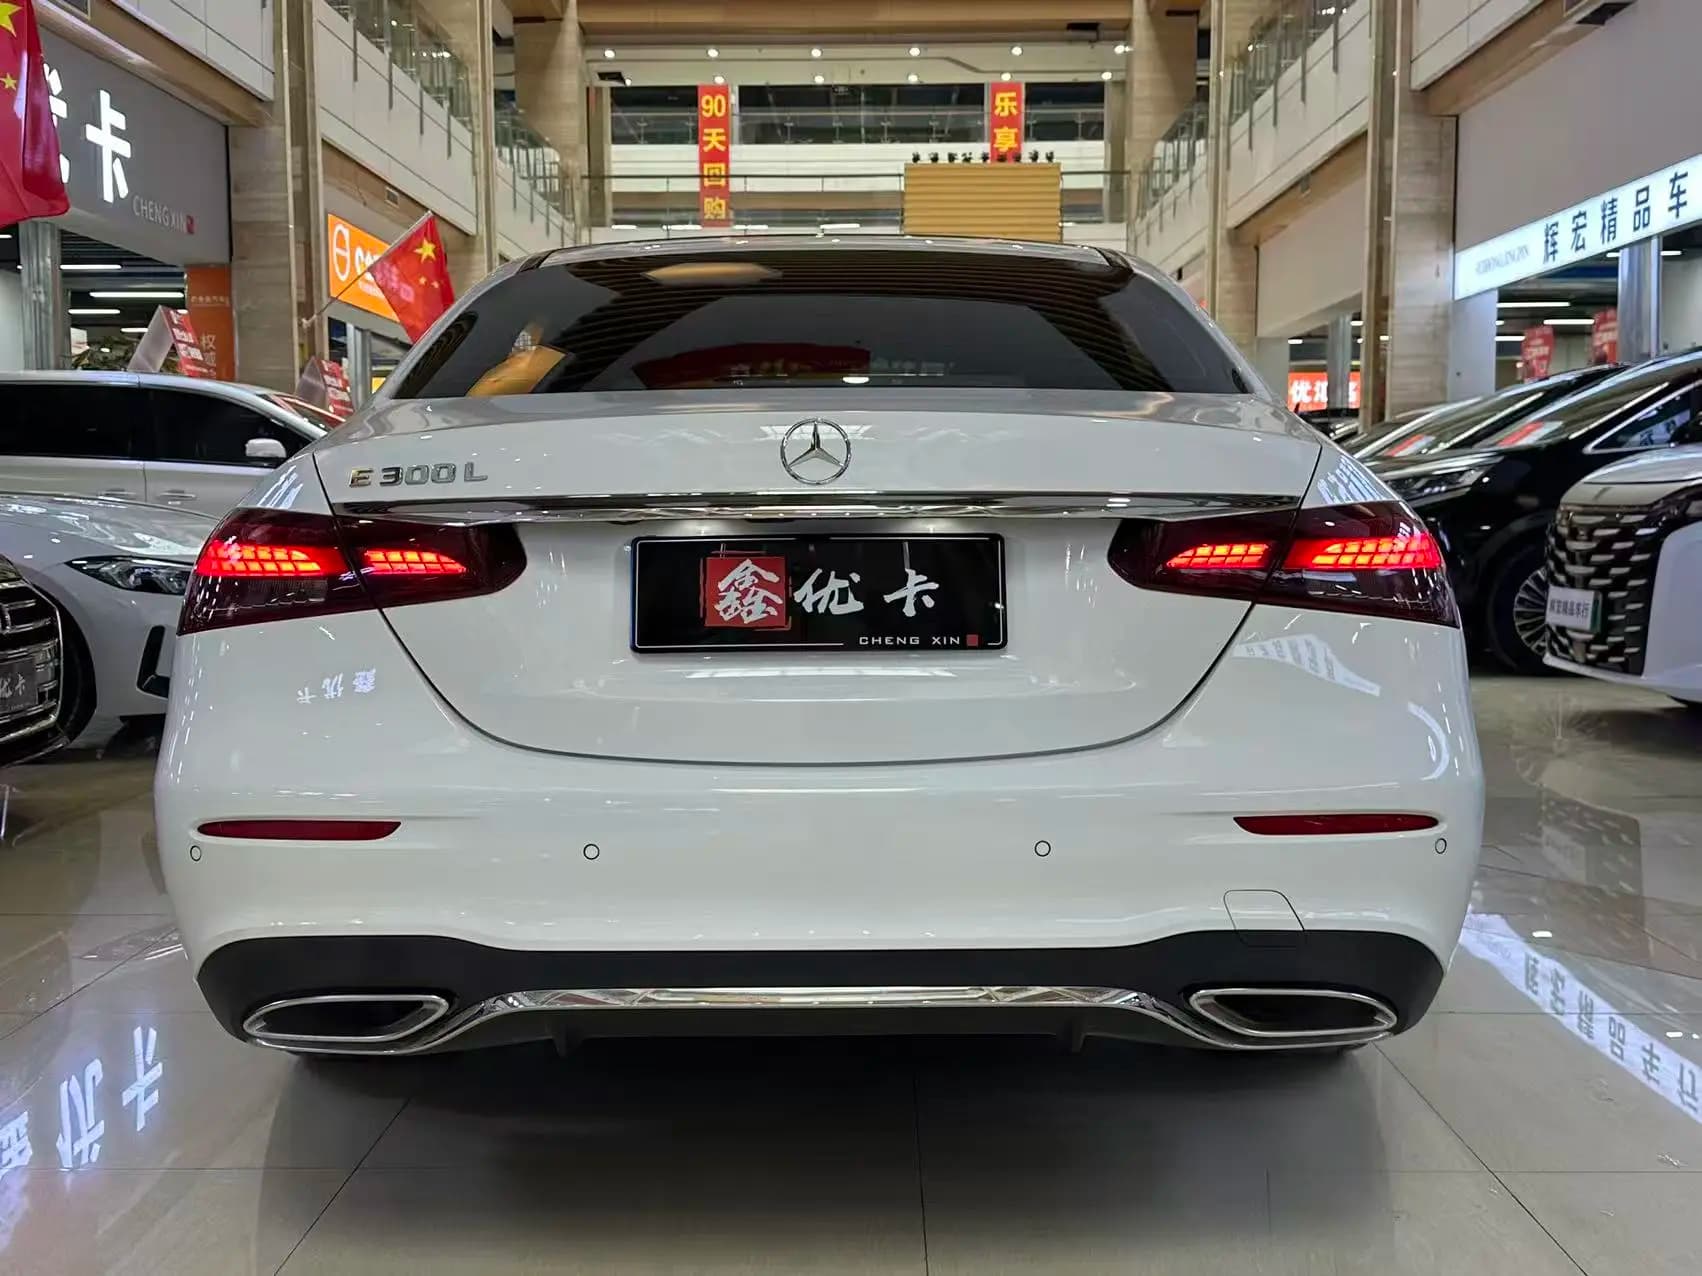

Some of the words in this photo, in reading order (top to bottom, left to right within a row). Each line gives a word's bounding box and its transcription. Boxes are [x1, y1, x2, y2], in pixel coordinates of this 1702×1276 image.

[993, 91, 1018, 153] 乐享
[1543, 171, 1689, 264] 辉宏精品车
[859, 636, 920, 646] CHENG
[932, 636, 960, 645] XIN
